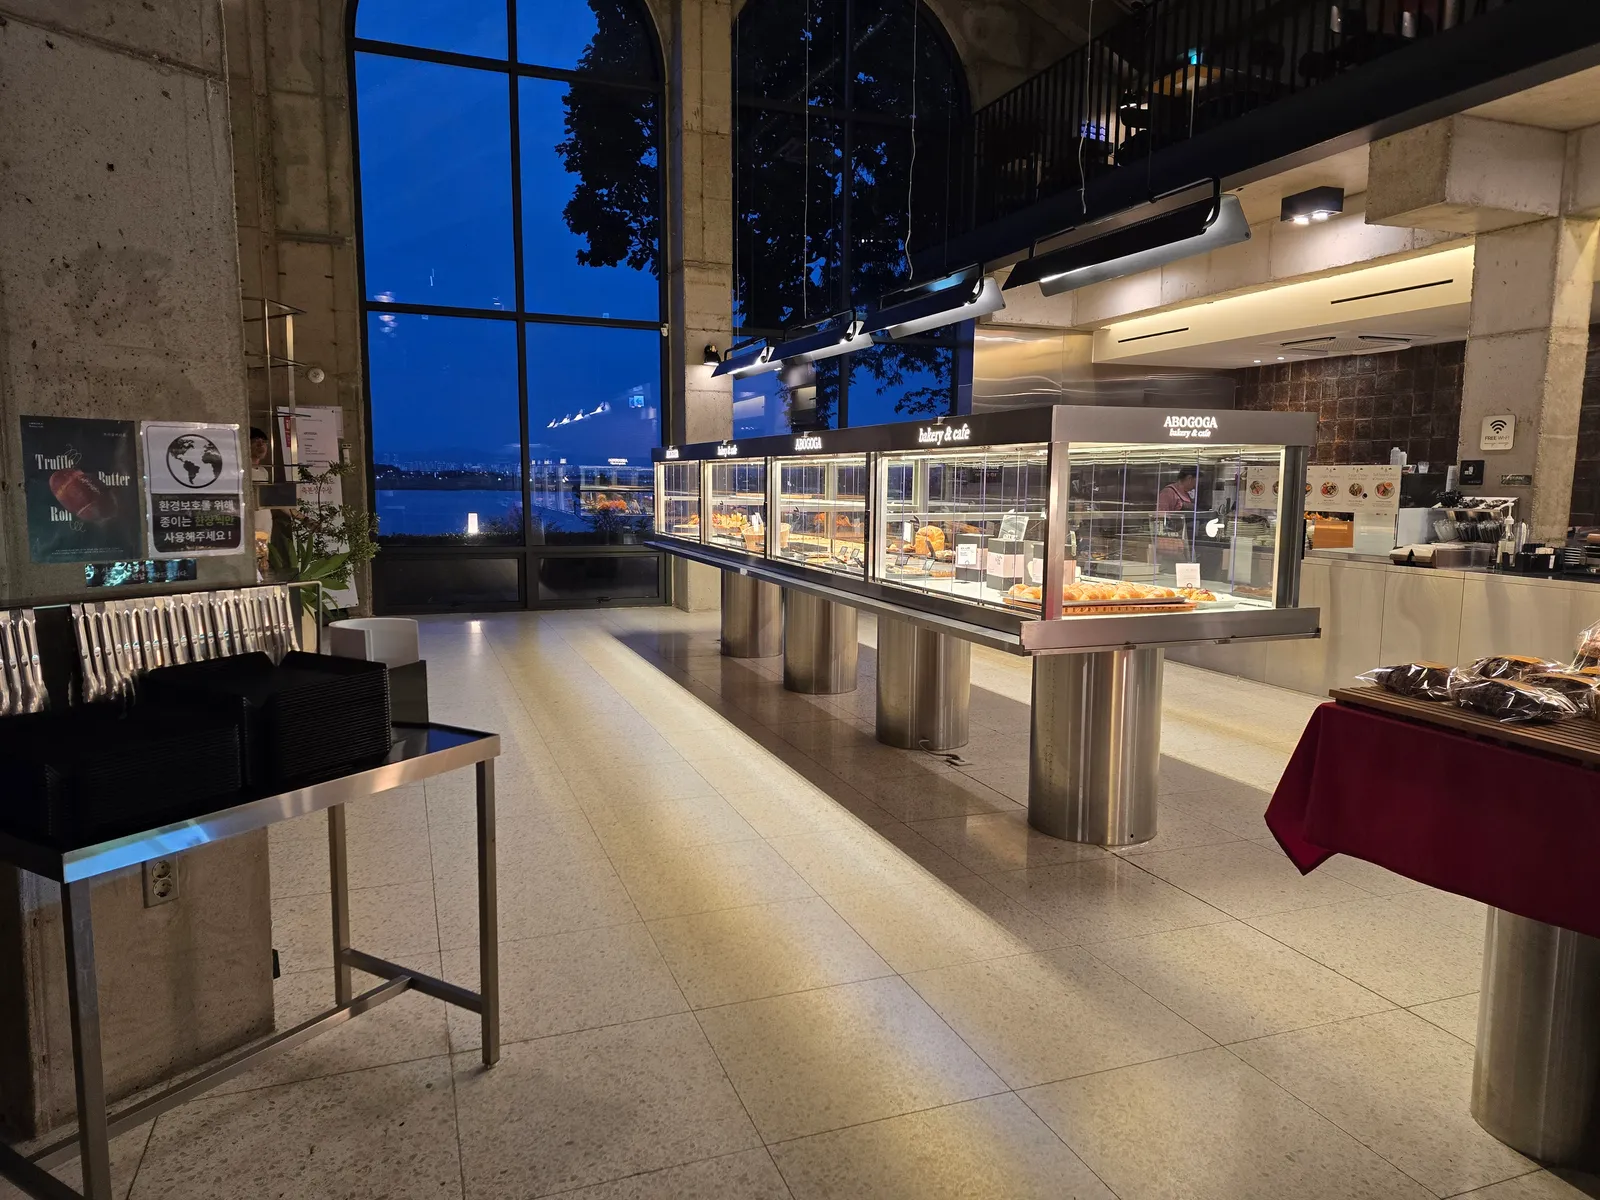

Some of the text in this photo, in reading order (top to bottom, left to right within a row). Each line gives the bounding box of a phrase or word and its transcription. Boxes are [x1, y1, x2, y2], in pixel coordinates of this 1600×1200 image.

[1164, 415, 1218, 429] ABOGOGA
[918, 423, 970, 446] bakery & cafe
[1169, 428, 1191, 439] bakery
[795, 437, 822, 451] ABOGOGA
[35, 454, 74, 470] Truffle
[98, 471, 130, 486] Butter
[159, 500, 235, 511] 환경보호를 위해
[50, 506, 72, 522] Roll
[160, 515, 235, 528] 종이는 한장씩만
[164, 531, 226, 543] 사용해주세요
